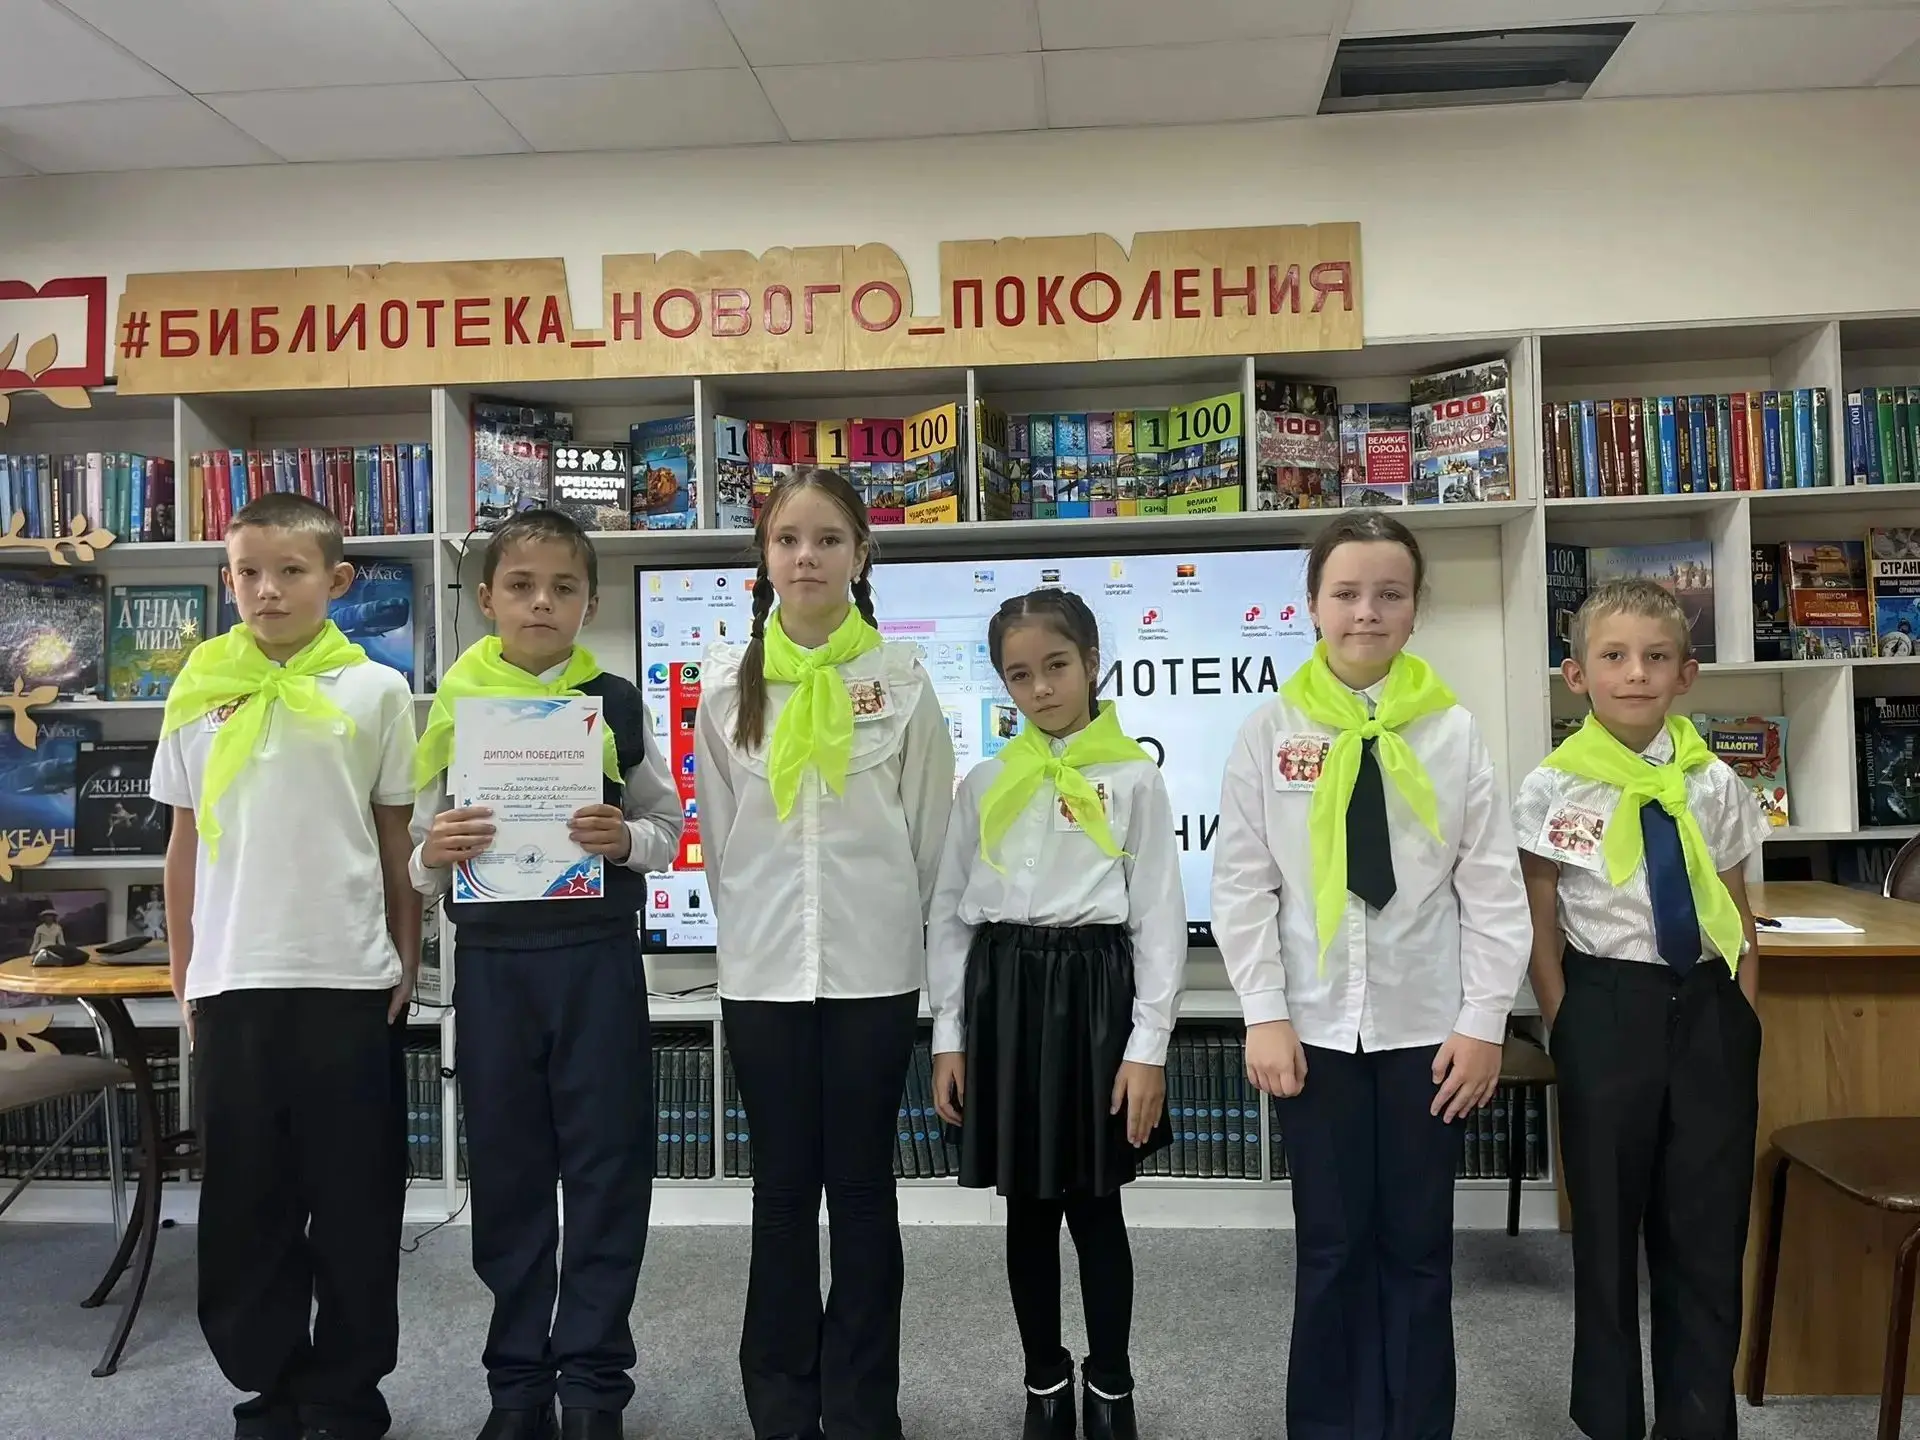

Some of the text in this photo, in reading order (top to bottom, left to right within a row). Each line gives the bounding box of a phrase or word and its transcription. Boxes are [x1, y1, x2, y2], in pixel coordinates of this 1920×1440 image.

[1432, 395, 1487, 421] 100
[1176, 402, 1232, 443] 100
[1274, 416, 1321, 437] 100
[860, 425, 903, 457] 10
[908, 413, 949, 454] 100
[1367, 435, 1407, 446] ВЕЛИКИЕ
[1426, 425, 1493, 451] ЗАМКОВ
[1367, 444, 1408, 455] ГОРОДА
[555, 474, 626, 491] КРЕПОСТИ
[562, 486, 619, 501] РОССИИ
[1186, 496, 1218, 508] великих
[869, 515, 900, 524] учших
[355, 563, 403, 580] Атлас
[1551, 549, 1576, 575] 100
[116, 598, 198, 630] АТЛАС
[135, 629, 183, 650] МИРА
[483, 750, 585, 760] ДИПЛОМ ПОБЕДИТЕЛЯ
[1715, 741, 1759, 752] НАЛОГИ?
[89, 779, 151, 794] ЖИЗН
[1, 828, 75, 849] КЕАН
